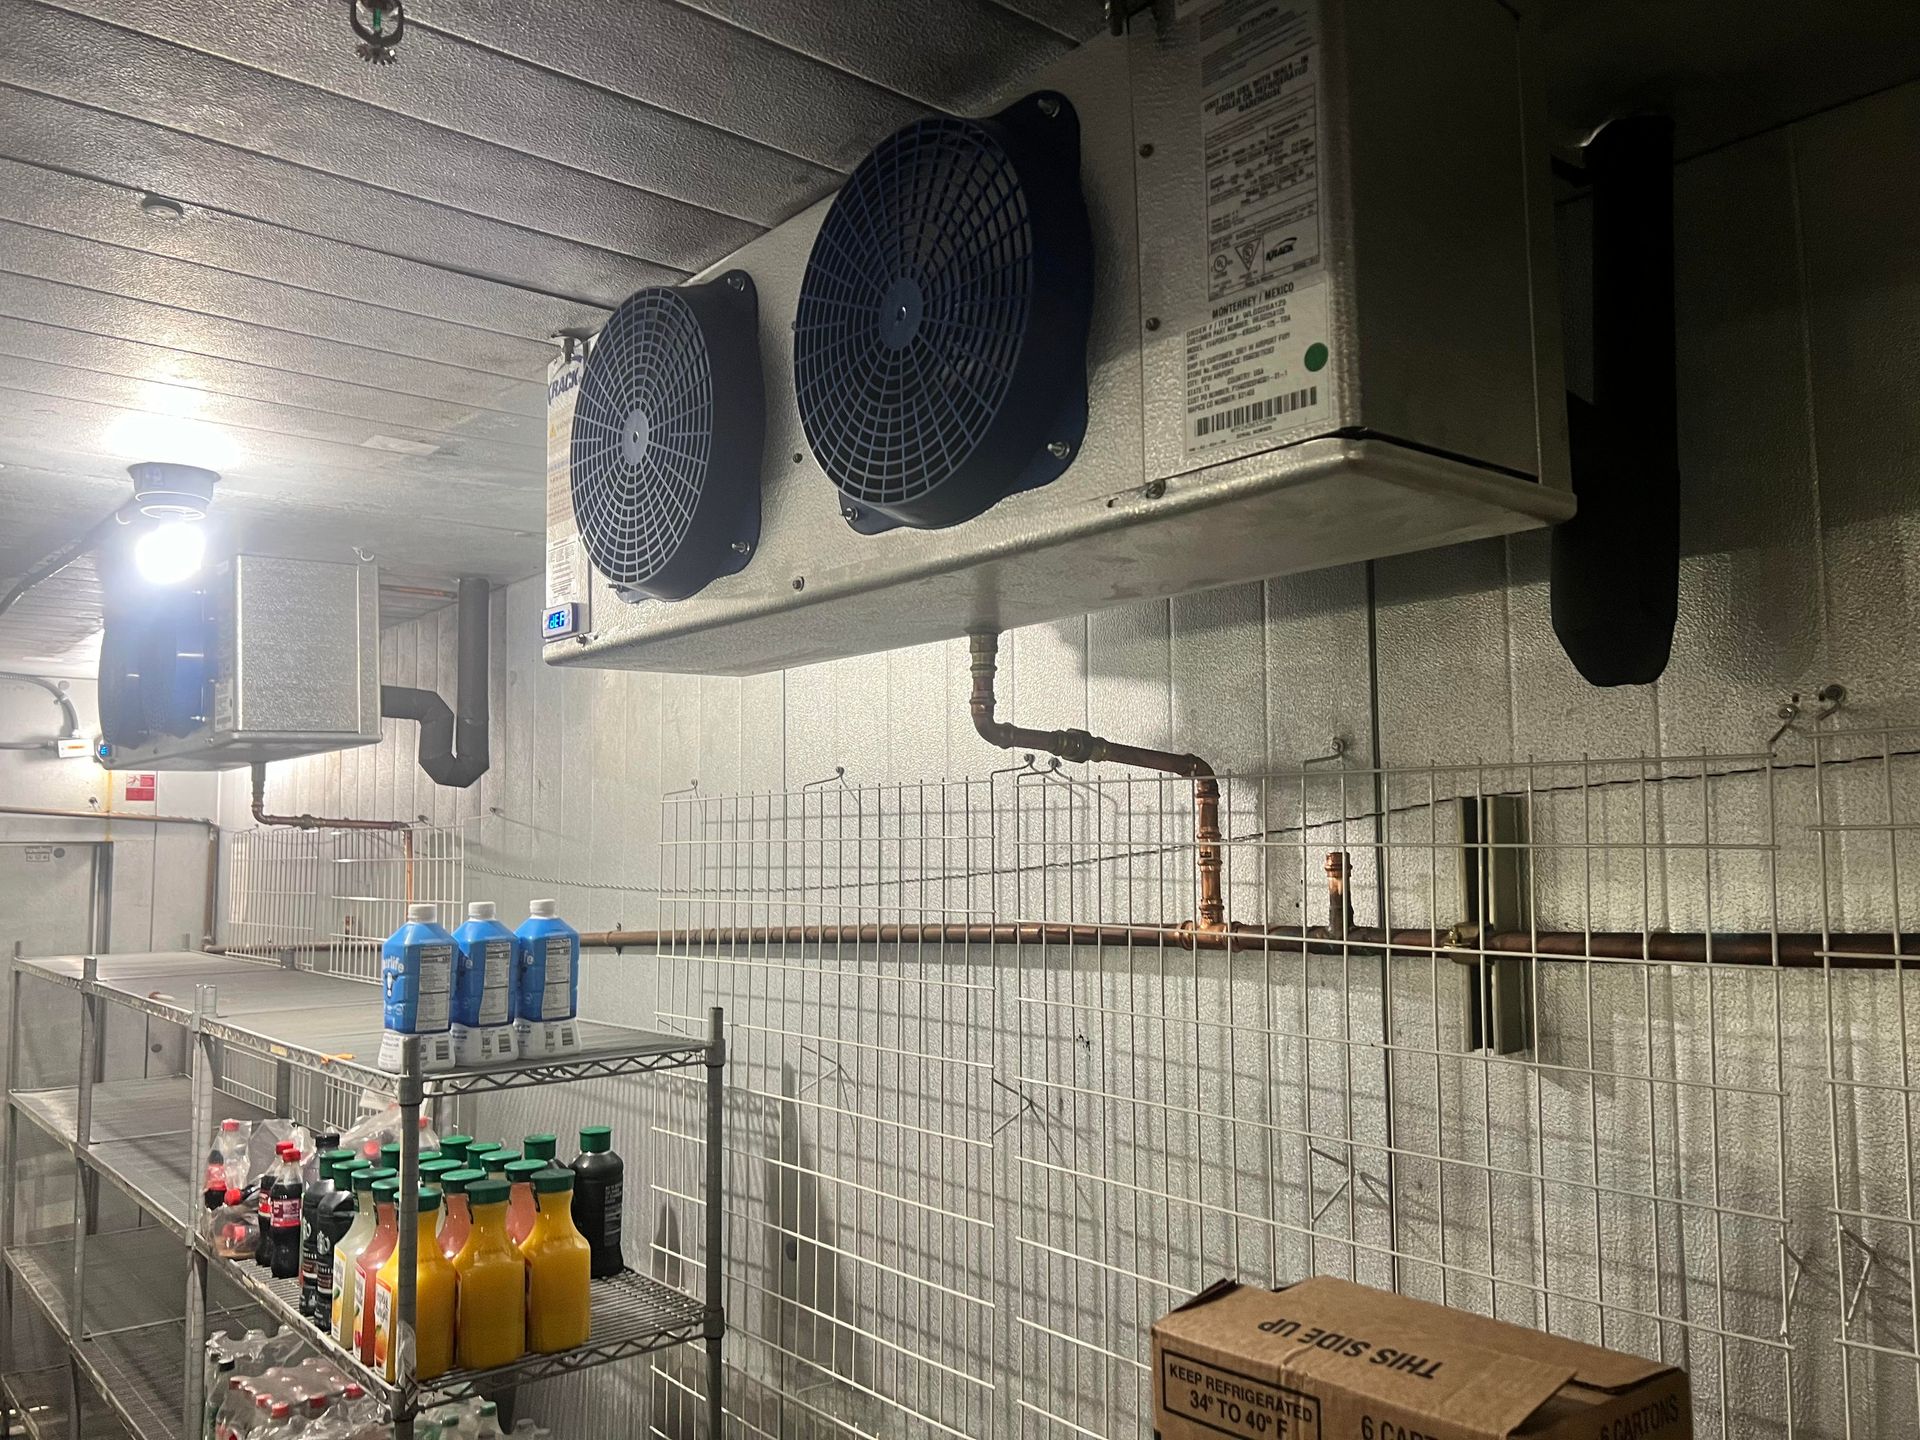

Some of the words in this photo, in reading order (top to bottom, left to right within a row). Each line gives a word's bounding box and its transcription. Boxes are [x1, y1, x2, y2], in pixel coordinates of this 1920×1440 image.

[1212, 296, 1257, 319] MONTERREY
[1264, 282, 1294, 301] MEXICO
[1258, 1318, 1301, 1338] UP
[1297, 1327, 1371, 1358] SIDE
[1370, 1348, 1444, 1380] THIS
[1169, 1362, 1202, 1386] KEEP
[1206, 1374, 1312, 1423] REFRIGERATED
[1217, 1398, 1241, 1424] TO
[1277, 1419, 1288, 1440] F
[1362, 1415, 1374, 1440] 6
[1614, 1392, 1679, 1440] CARTONS
